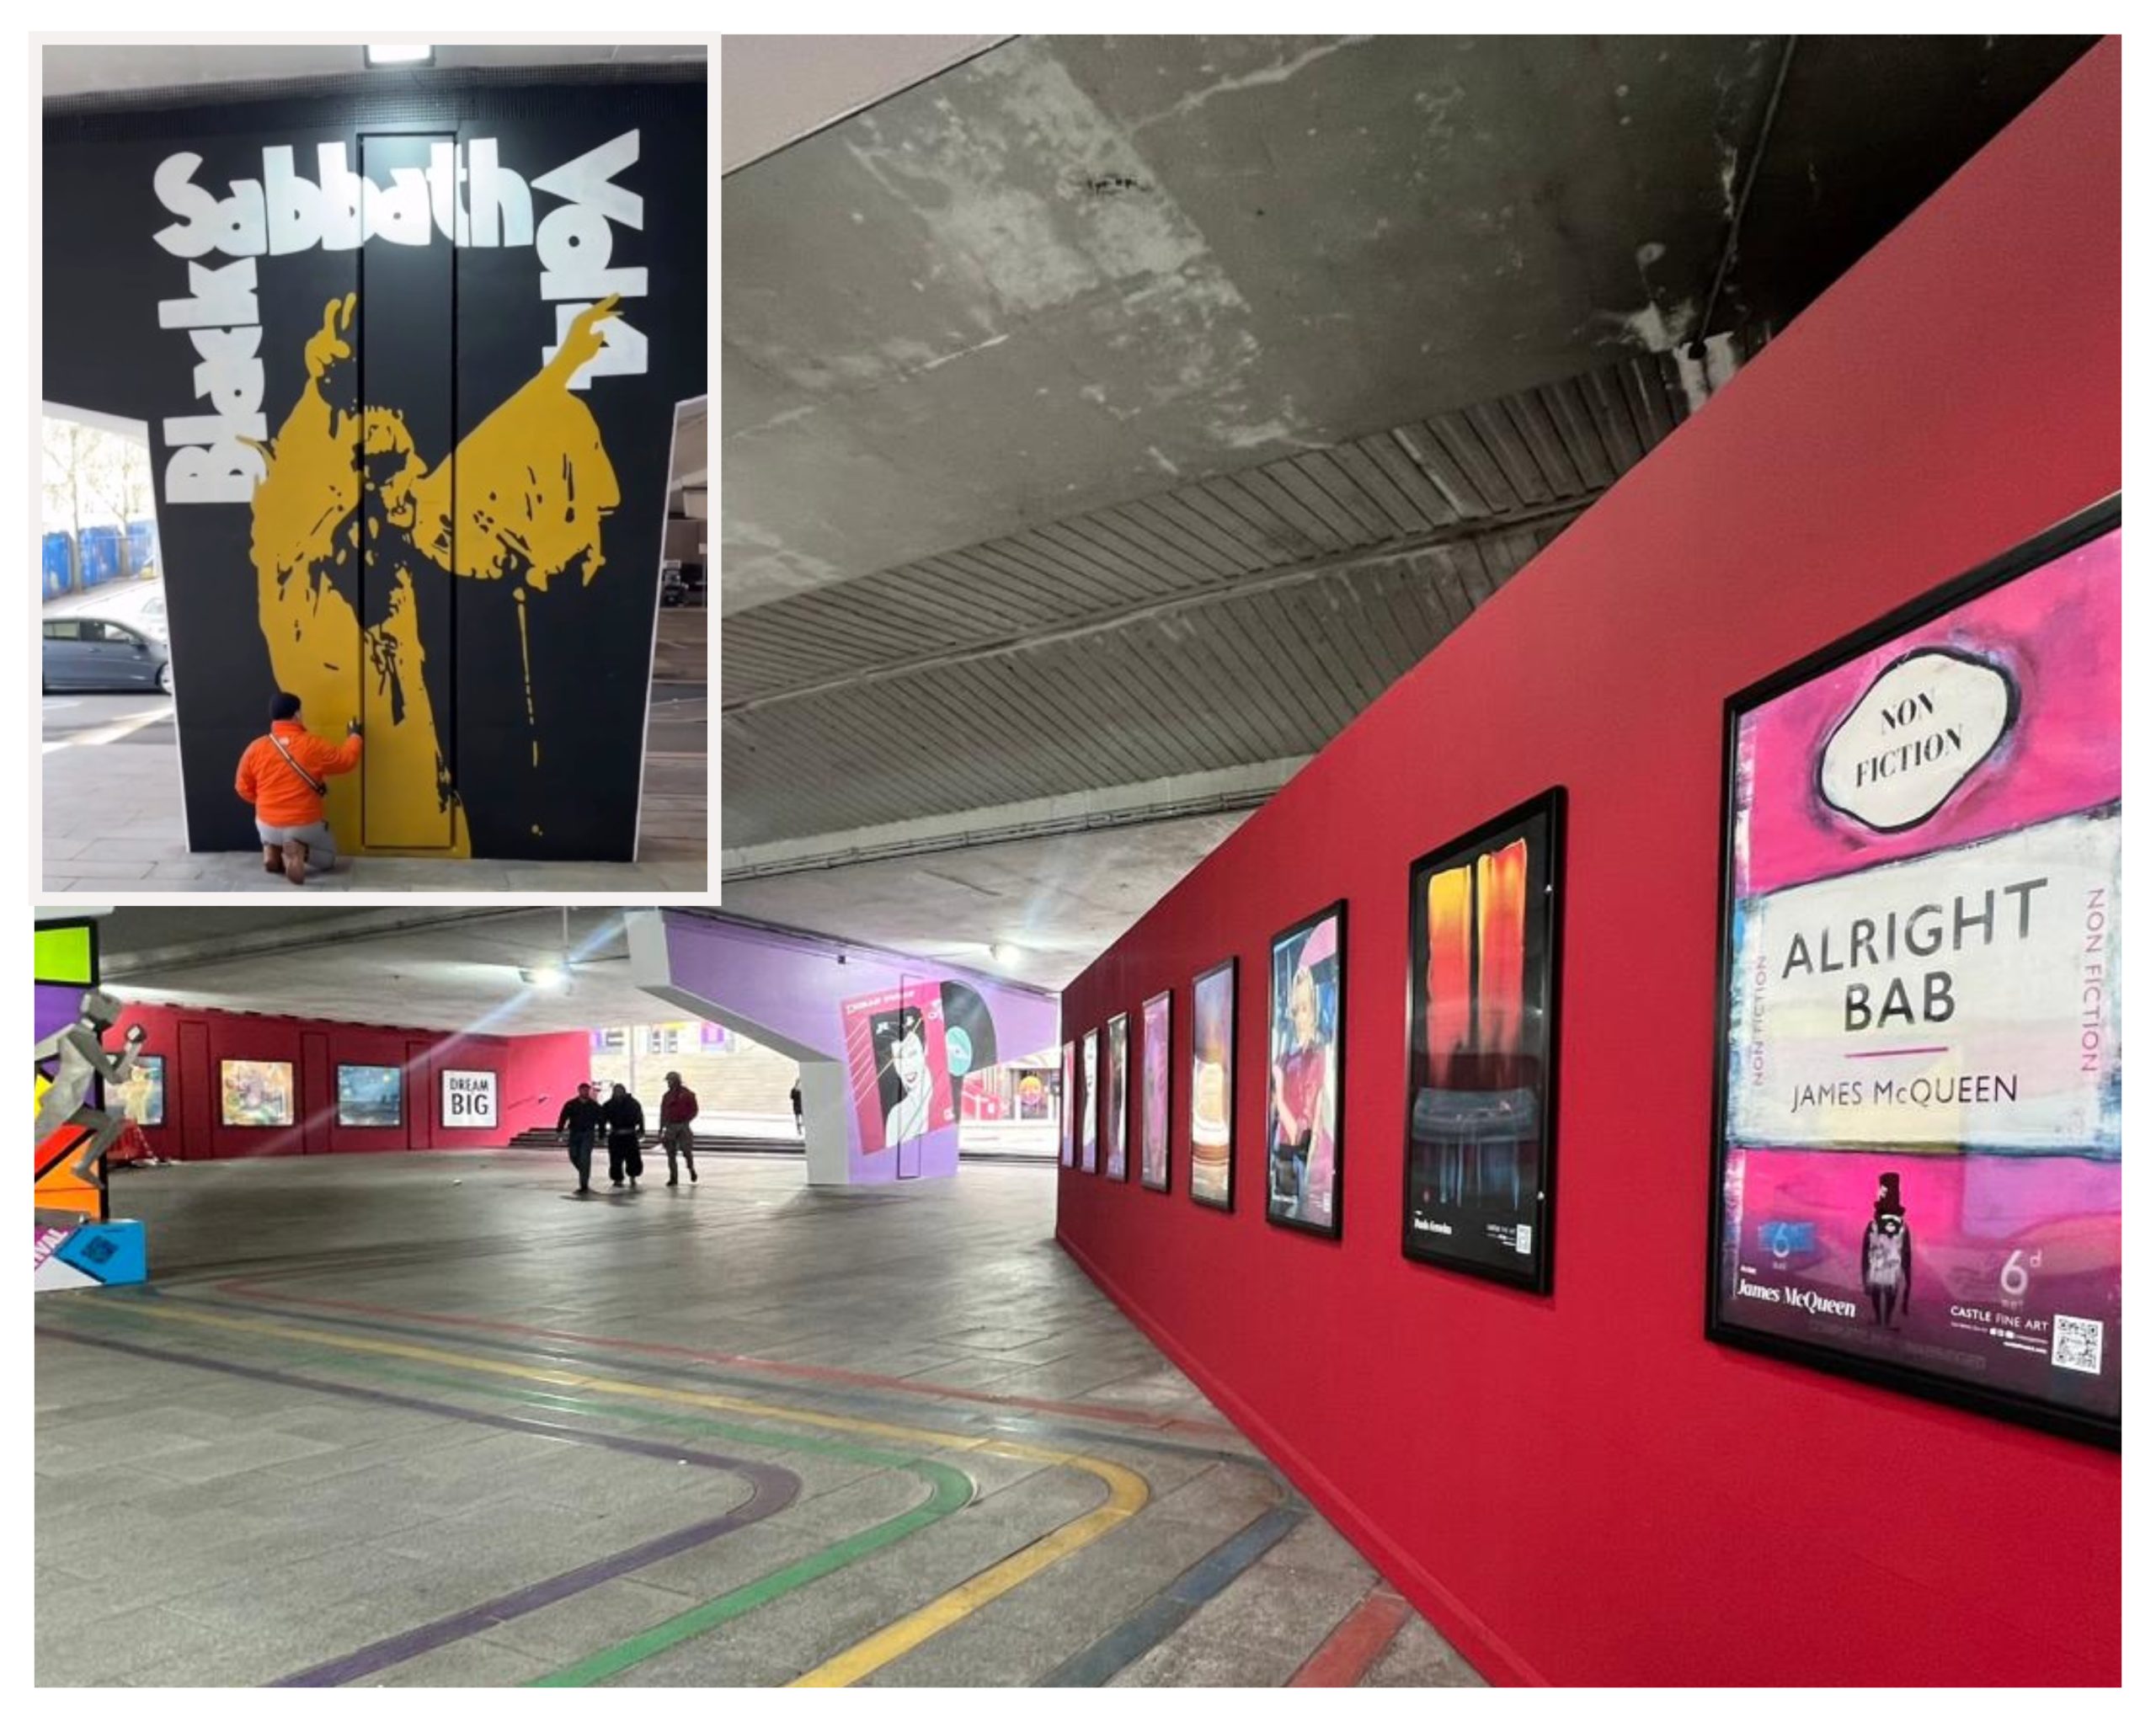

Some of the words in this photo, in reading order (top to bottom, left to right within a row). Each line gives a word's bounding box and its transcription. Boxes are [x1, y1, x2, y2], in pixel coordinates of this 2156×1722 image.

[152, 137, 534, 258] Sabbath
[531, 128, 648, 301] Vol
[157, 256, 270, 504] Black
[1881, 688, 1935, 736] NON
[1855, 723, 1964, 787] FICTION
[1781, 877, 2048, 978] ALRIGHT
[2084, 888, 2105, 953] NON
[1752, 956, 1767, 1040] FICTION
[1844, 970, 1956, 1032] BAB
[2081, 963, 2102, 1072] FICTION
[450, 1078, 488, 1091] DREAM
[1752, 1041, 1764, 1086] NON
[1790, 1081, 1862, 1113] JAMES
[1873, 1074, 2018, 1108] McQUEEN
[451, 1093, 488, 1116] BIG
[1737, 1278, 1780, 1303] James
[1784, 1287, 1856, 1318] McQueen
[1950, 1305, 1991, 1323] CASTLE
[1995, 1312, 2021, 1328] FINE
[2024, 1318, 2049, 1331] ART
